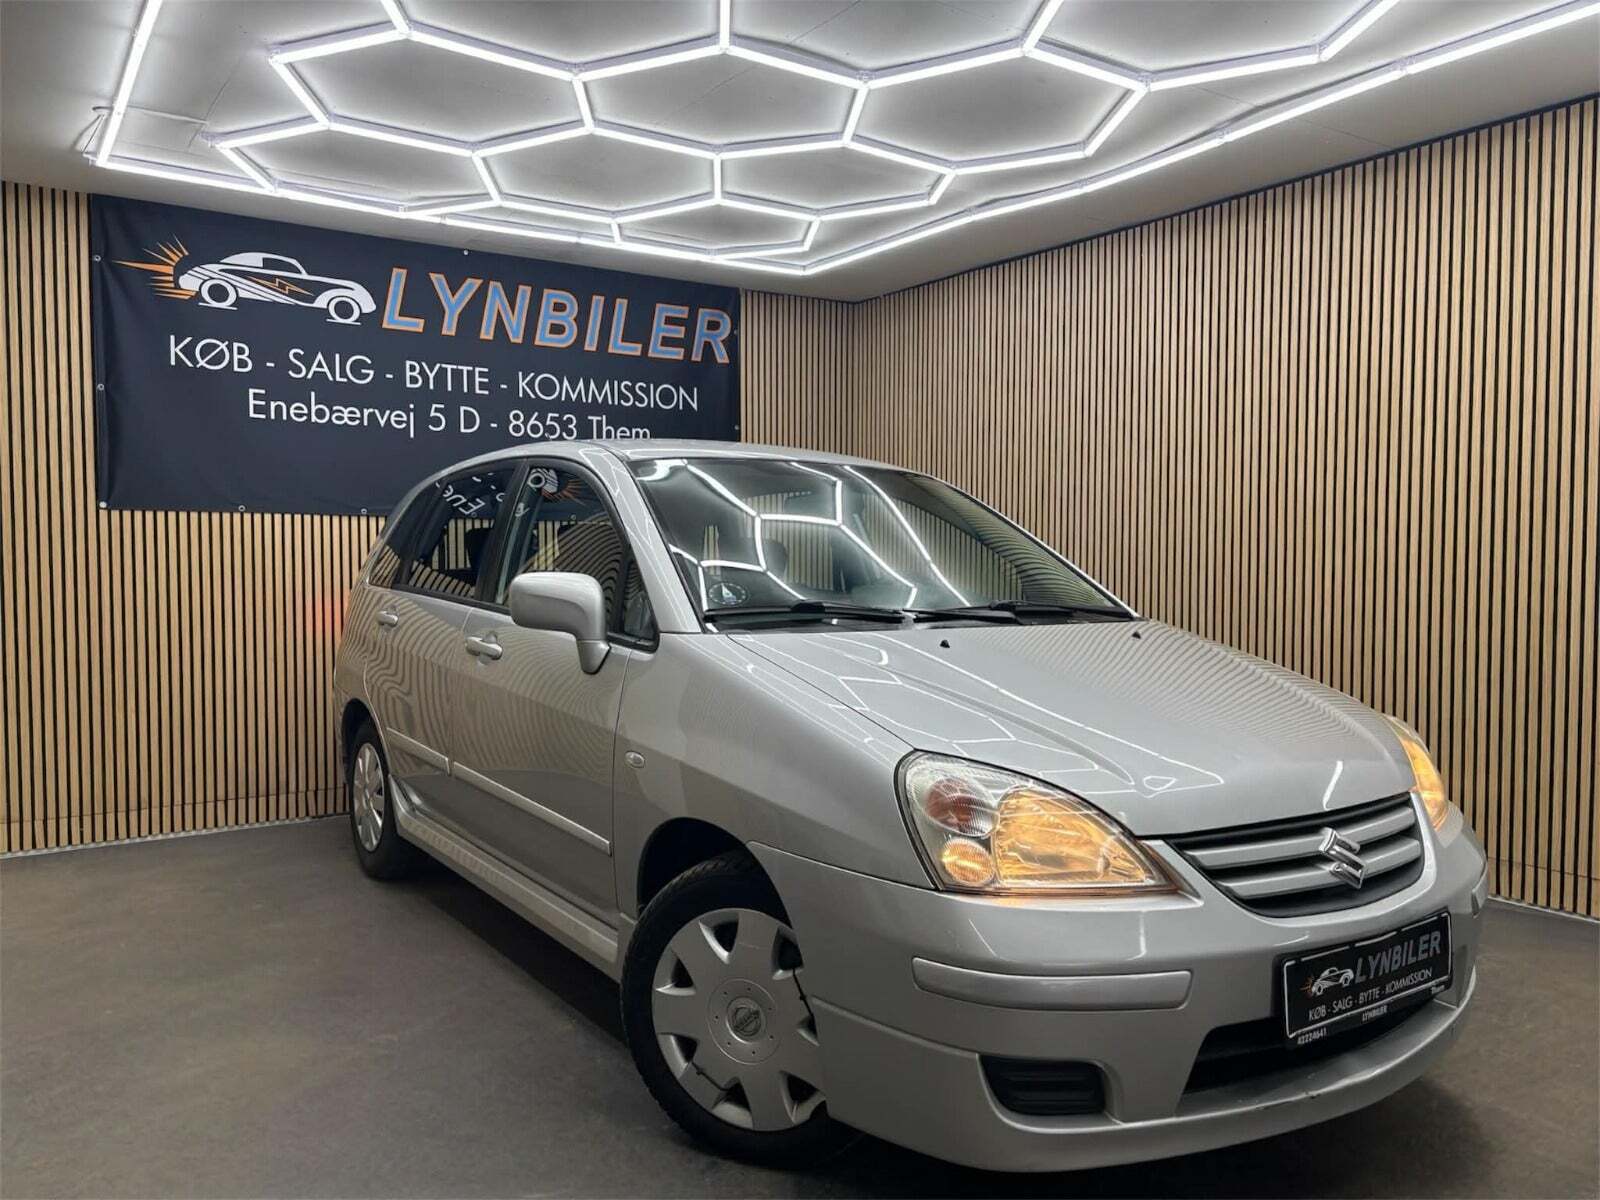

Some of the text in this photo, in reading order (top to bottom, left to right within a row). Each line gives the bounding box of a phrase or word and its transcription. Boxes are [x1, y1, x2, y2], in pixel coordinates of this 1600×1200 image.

[382, 267, 732, 364] LYNBILER
[169, 334, 253, 373] KØB
[288, 348, 376, 384] SALG
[405, 360, 490, 396] BYTTE
[518, 371, 699, 412] KOMMISSION
[248, 388, 415, 439] Enebærvej
[428, 403, 447, 432] 5
[459, 405, 481, 433] D
[508, 409, 578, 441] 8653
[587, 414, 651, 440] Them
[1354, 930, 1441, 984] LYNBILER
[1308, 1004, 1327, 1021] KØB
[1332, 995, 1353, 1013] SALG
[1359, 986, 1381, 1004] BYTTE
[1385, 966, 1433, 995] KOMMISSION
